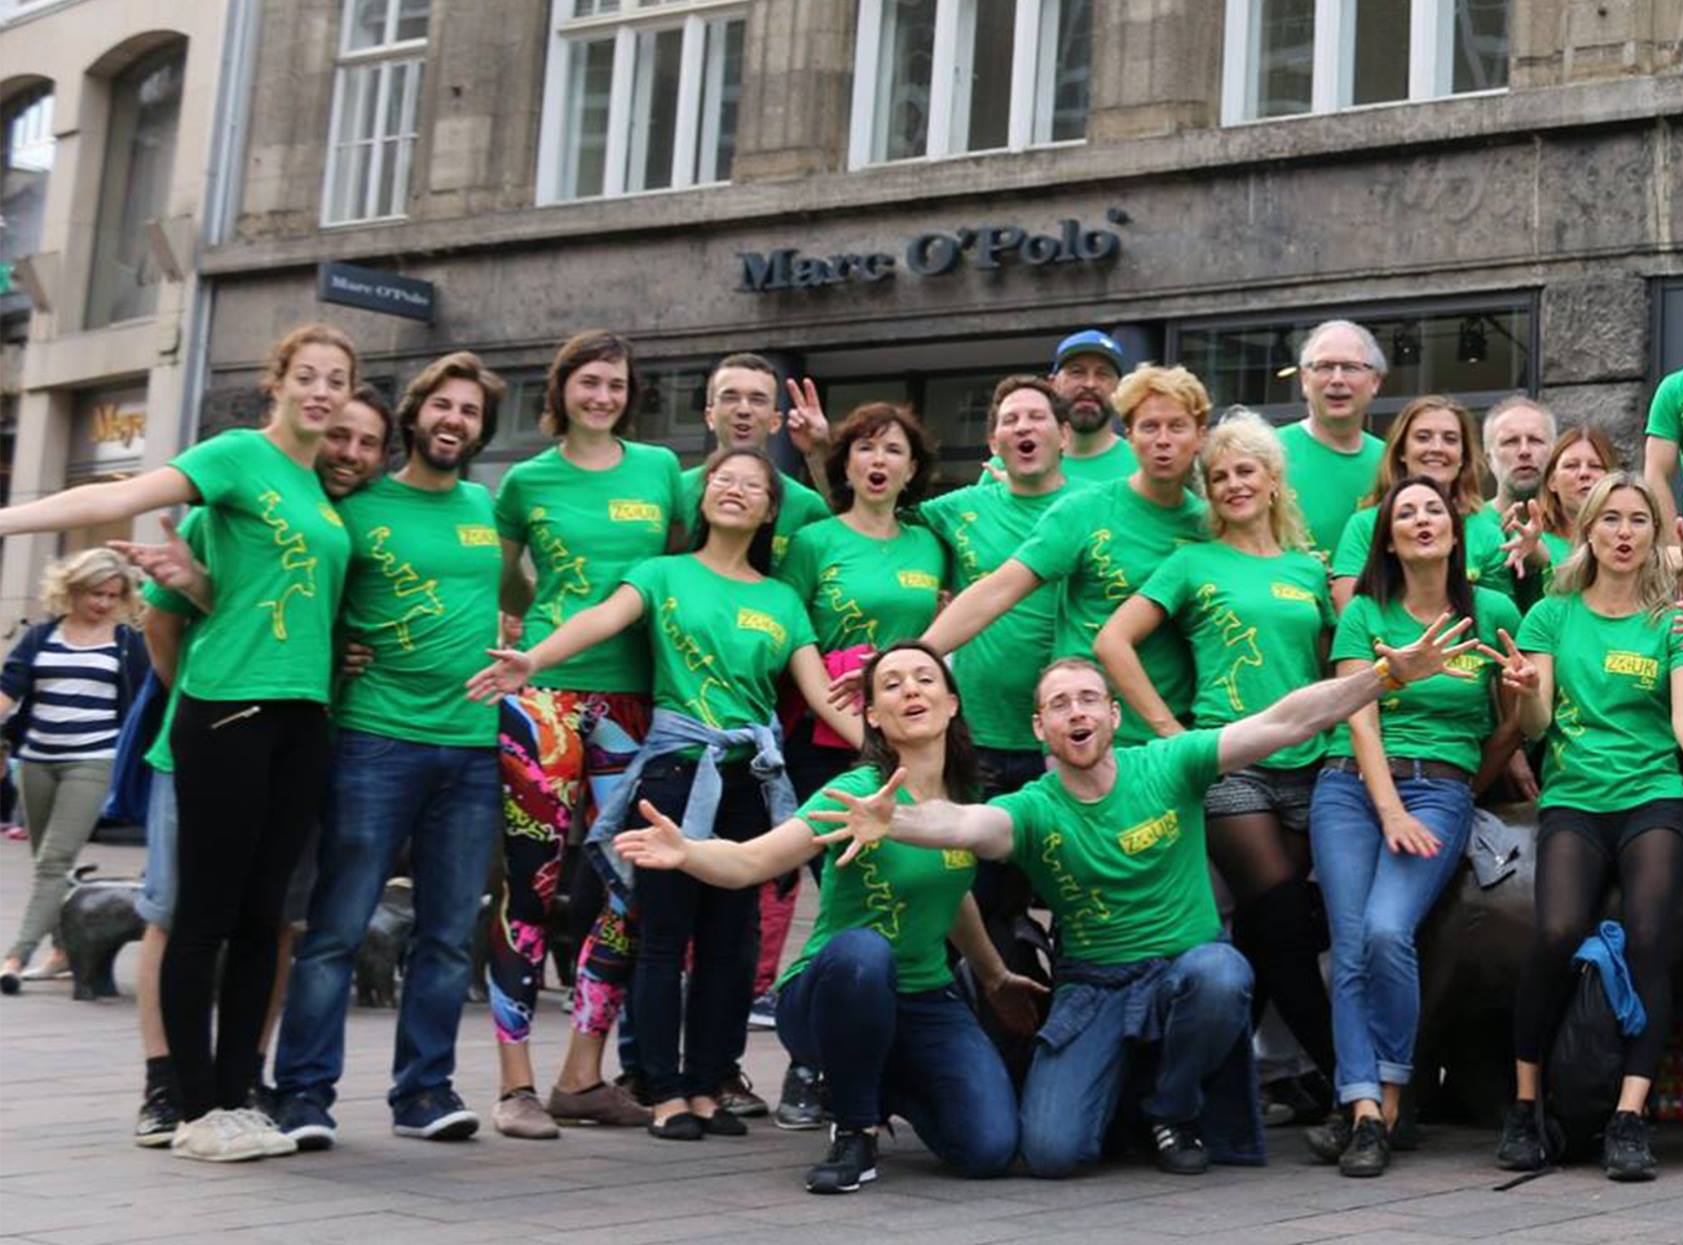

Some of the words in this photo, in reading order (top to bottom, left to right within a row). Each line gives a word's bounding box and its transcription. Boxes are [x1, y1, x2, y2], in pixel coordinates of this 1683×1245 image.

[735, 248, 896, 293] Marc
[906, 218, 1121, 276] O'Polo
[1606, 655, 1655, 677] ZOUK
